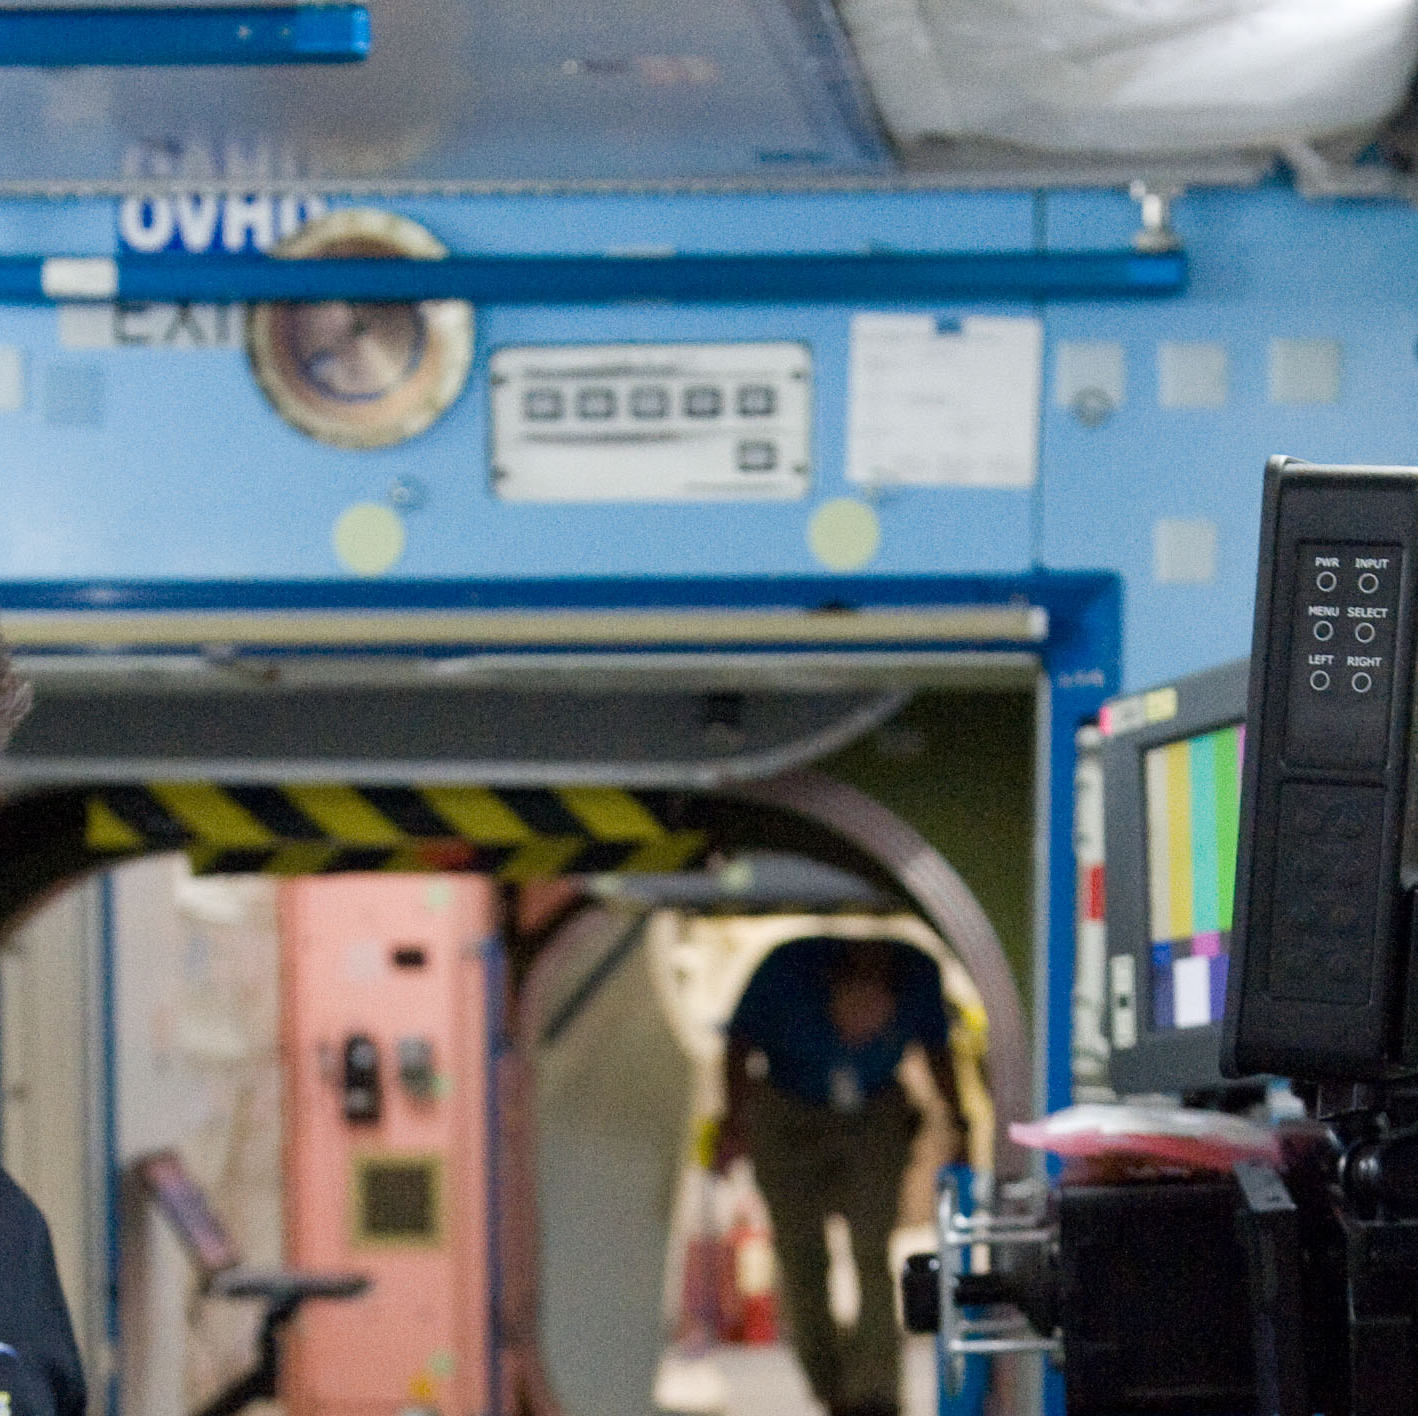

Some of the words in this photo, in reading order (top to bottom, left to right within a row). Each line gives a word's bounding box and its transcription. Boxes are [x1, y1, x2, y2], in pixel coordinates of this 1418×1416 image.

[1315, 556, 1341, 569] PWR
[1355, 557, 1390, 570] INPUT
[1308, 605, 1340, 617] MENU
[1347, 606, 1389, 619] SELECT
[1308, 653, 1335, 665] LEFT
[1347, 655, 1383, 668] RIGHT
